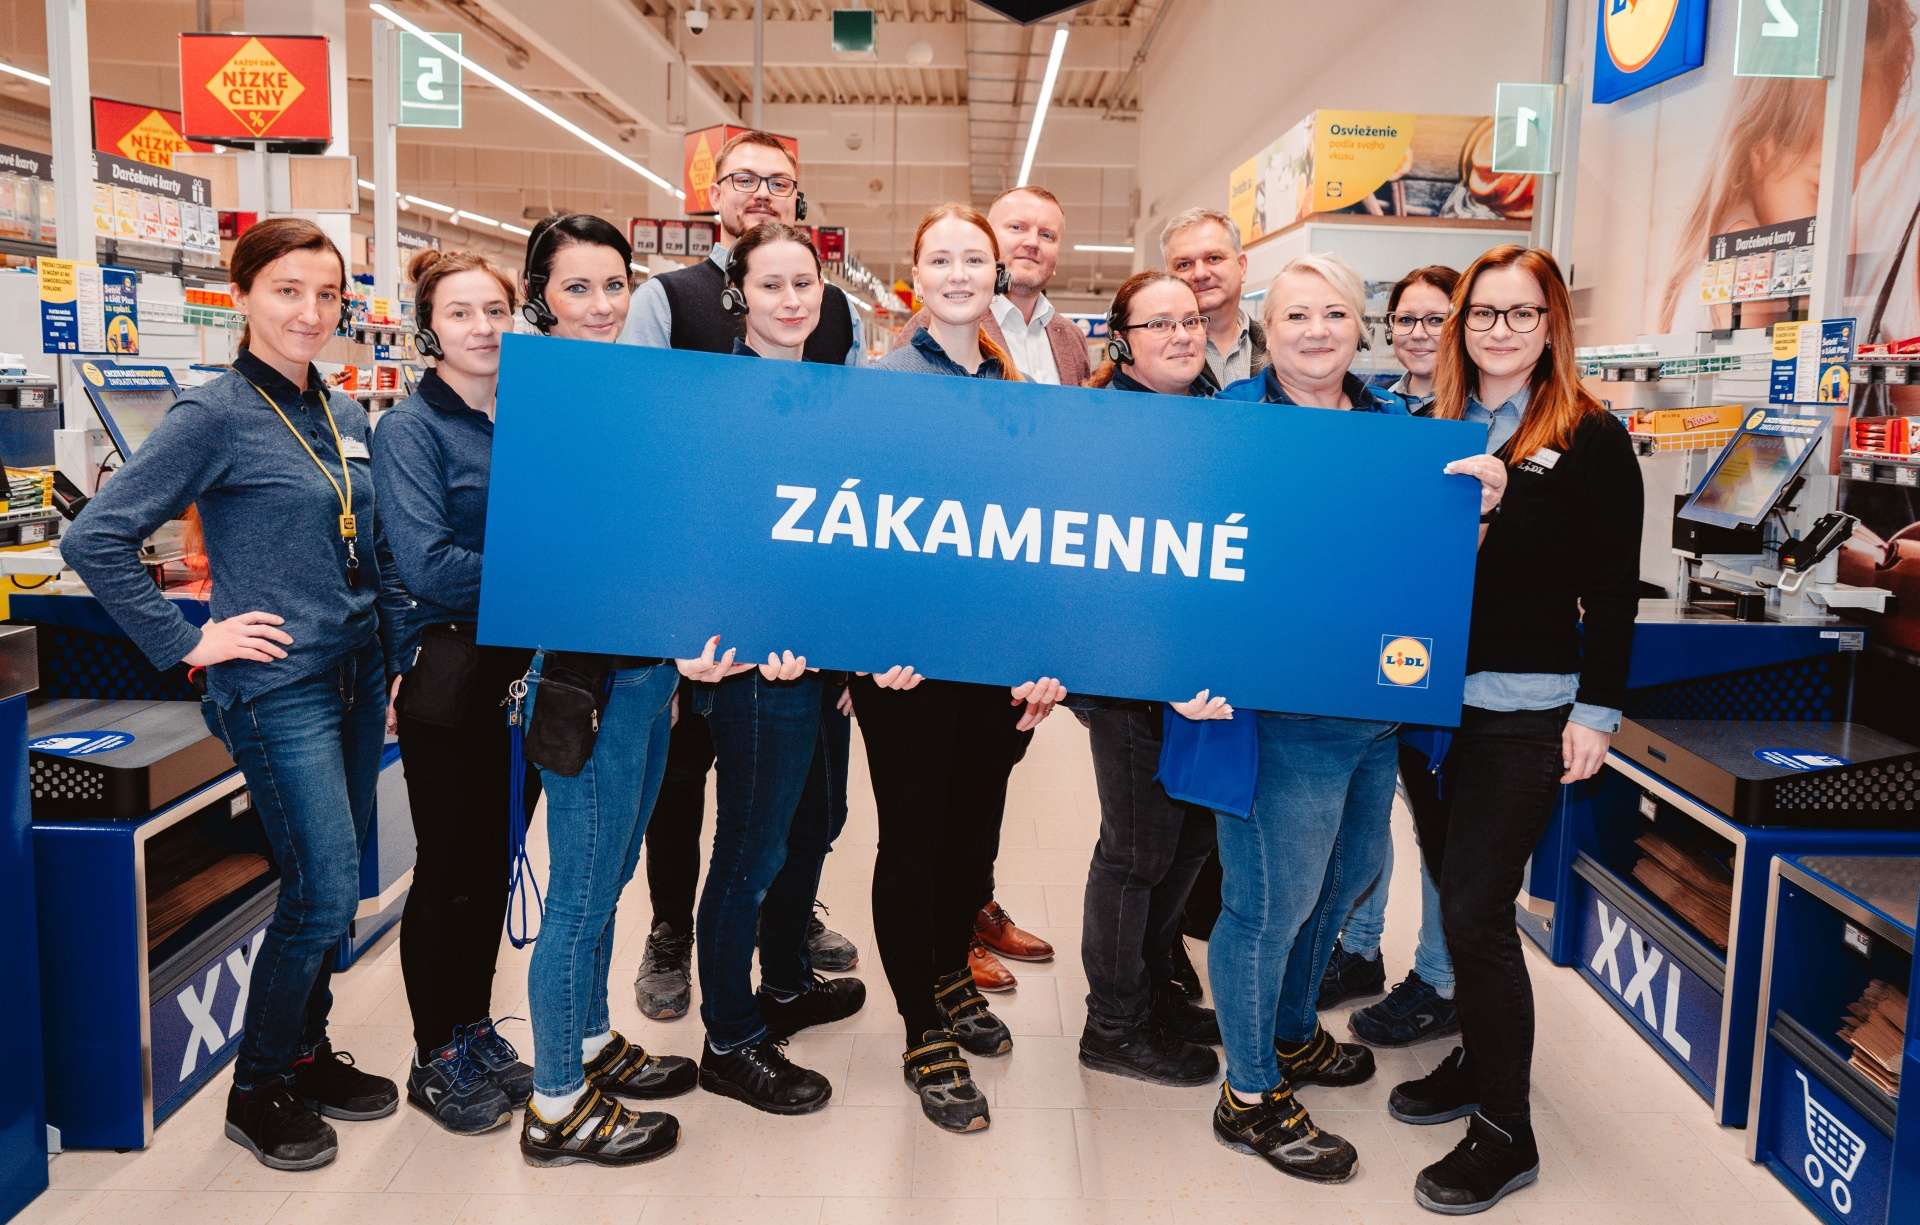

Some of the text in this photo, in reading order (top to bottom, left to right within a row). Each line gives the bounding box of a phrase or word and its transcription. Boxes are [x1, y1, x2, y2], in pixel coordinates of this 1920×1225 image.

[222, 67, 288, 88] NÍZKE
[228, 89, 284, 106] CENY
[1330, 124, 1398, 138] Osvieženie
[131, 132, 184, 153] NÍZKE
[0, 153, 39, 174] ové karty
[136, 150, 170, 166] CEN
[112, 163, 181, 196] Darčekové karty
[1735, 230, 1796, 251] Darčekové karty
[1517, 461, 1545, 475] LIDL
[771, 478, 1250, 583] ZÁKAMENNÉ
[1385, 651, 1425, 667] LIDL
[1590, 899, 1692, 1063] XXL
[176, 928, 266, 1083] XX
